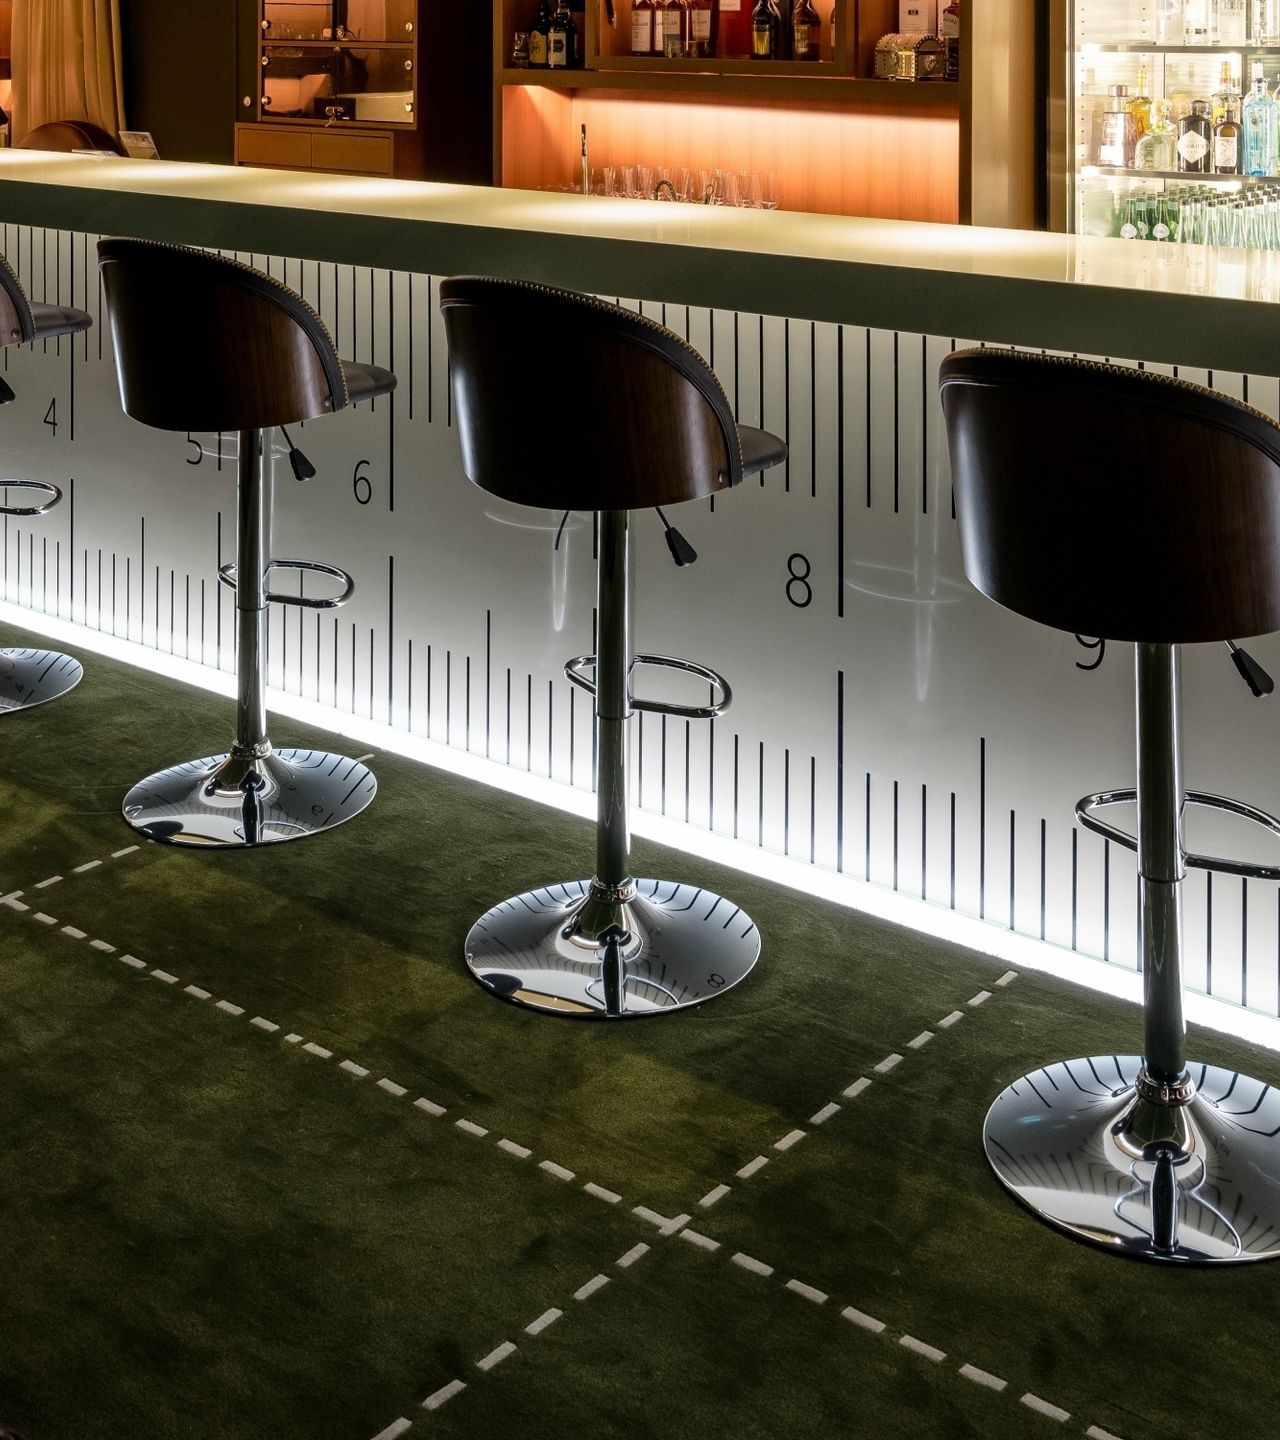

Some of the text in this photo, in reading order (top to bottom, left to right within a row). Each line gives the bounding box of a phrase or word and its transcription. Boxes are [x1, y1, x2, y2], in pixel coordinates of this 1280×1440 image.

[43, 397, 58, 437] 4
[353, 459, 372, 505] 6
[785, 552, 813, 608] 8
